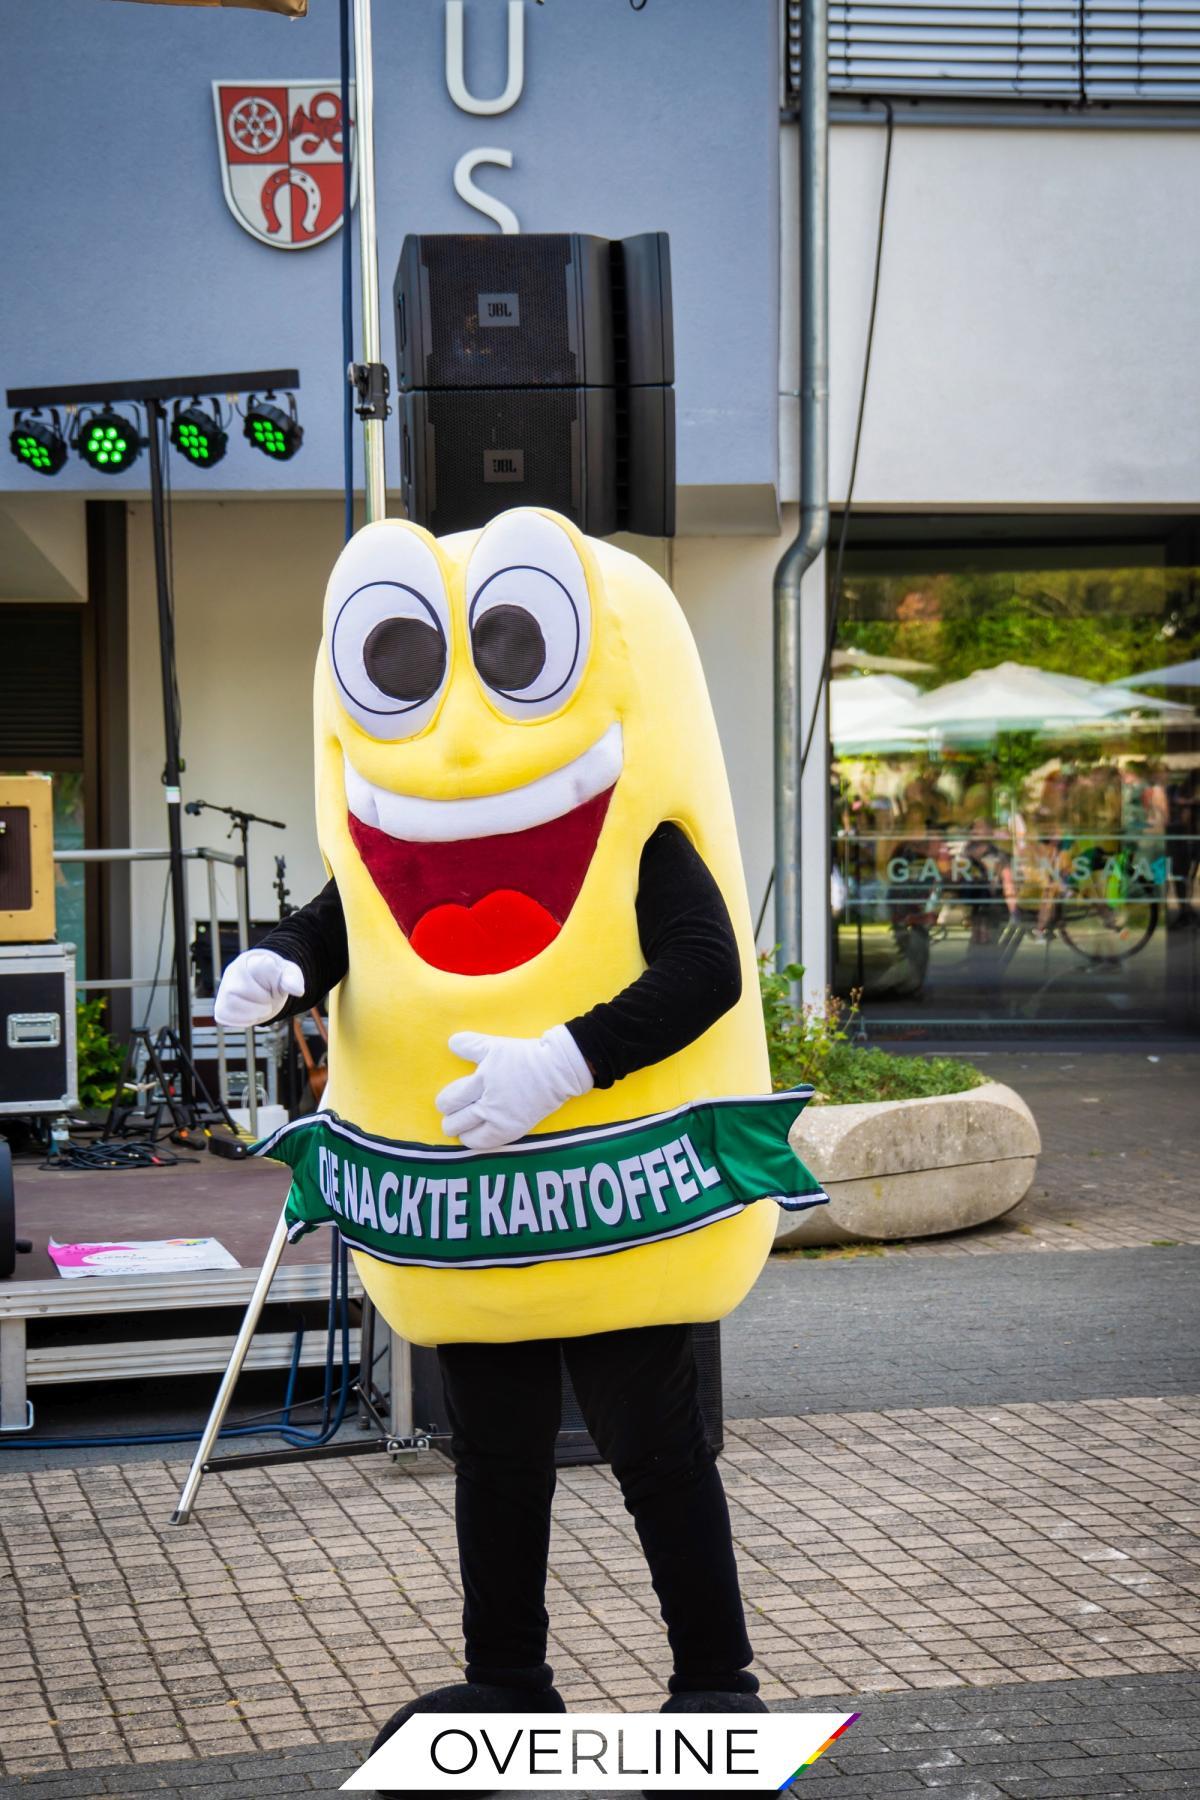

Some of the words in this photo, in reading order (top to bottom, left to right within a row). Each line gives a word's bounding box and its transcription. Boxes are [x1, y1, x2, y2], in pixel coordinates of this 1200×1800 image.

[488, 303, 512, 318] JBL
[493, 459, 517, 473] JBL
[887, 857, 1184, 882] GARTENSAAL
[319, 1146, 343, 1216] DIE
[344, 1159, 468, 1240] NACKTE
[480, 1133, 722, 1237] KARTOFFEL
